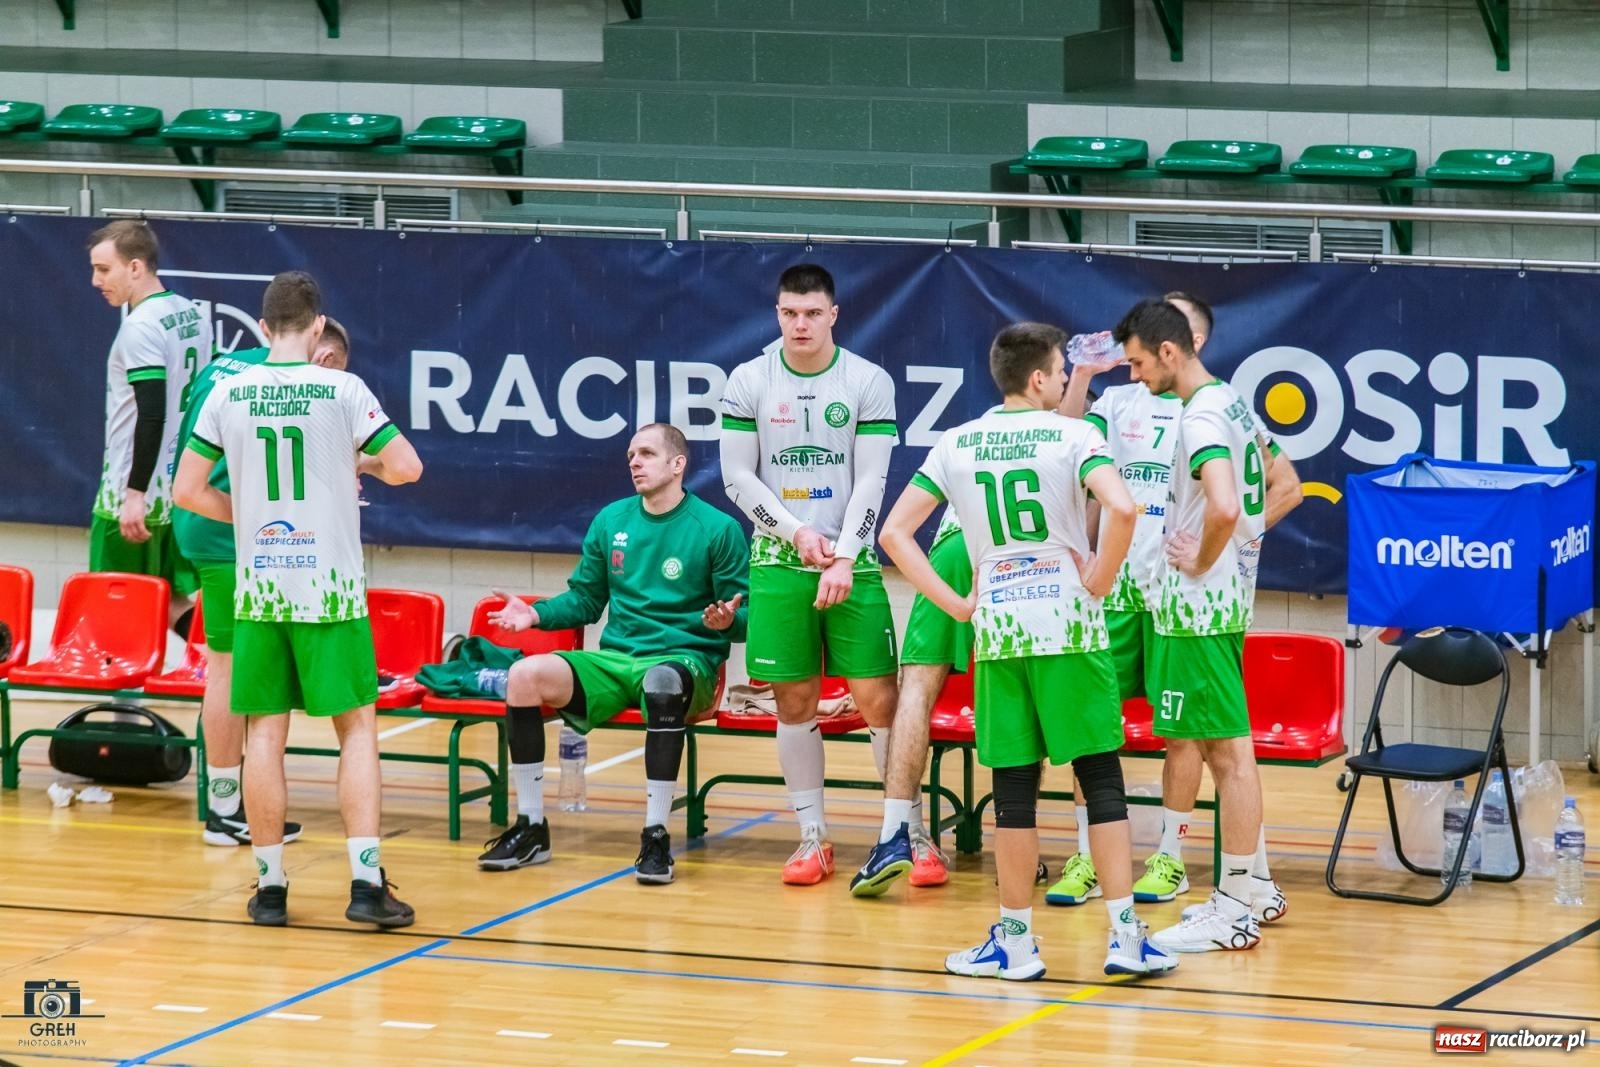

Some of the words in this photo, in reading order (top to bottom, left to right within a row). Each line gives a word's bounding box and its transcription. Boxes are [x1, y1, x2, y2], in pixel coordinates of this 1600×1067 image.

[230, 385, 257, 402] KLUB
[261, 384, 336, 400] SIATKARSKI
[410, 350, 964, 448] RACIBZ
[250, 399, 310, 416] RACIBÓRZ
[1230, 346, 1570, 467] OSiR
[805, 408, 810, 432] 1
[957, 432, 983, 448] KLUB
[986, 429, 1062, 444] SIATKARSKI
[1153, 426, 1165, 449] 7
[257, 426, 304, 501] 11
[975, 444, 1037, 461] RACIBÓRZ
[975, 469, 1048, 546] 16
[612, 549, 625, 568] R
[1377, 535, 1512, 569] molten
[990, 566, 1060, 583] UBEZPIECZENIA
[885, 628, 894, 657] 1
[1161, 690, 1184, 721] 97
